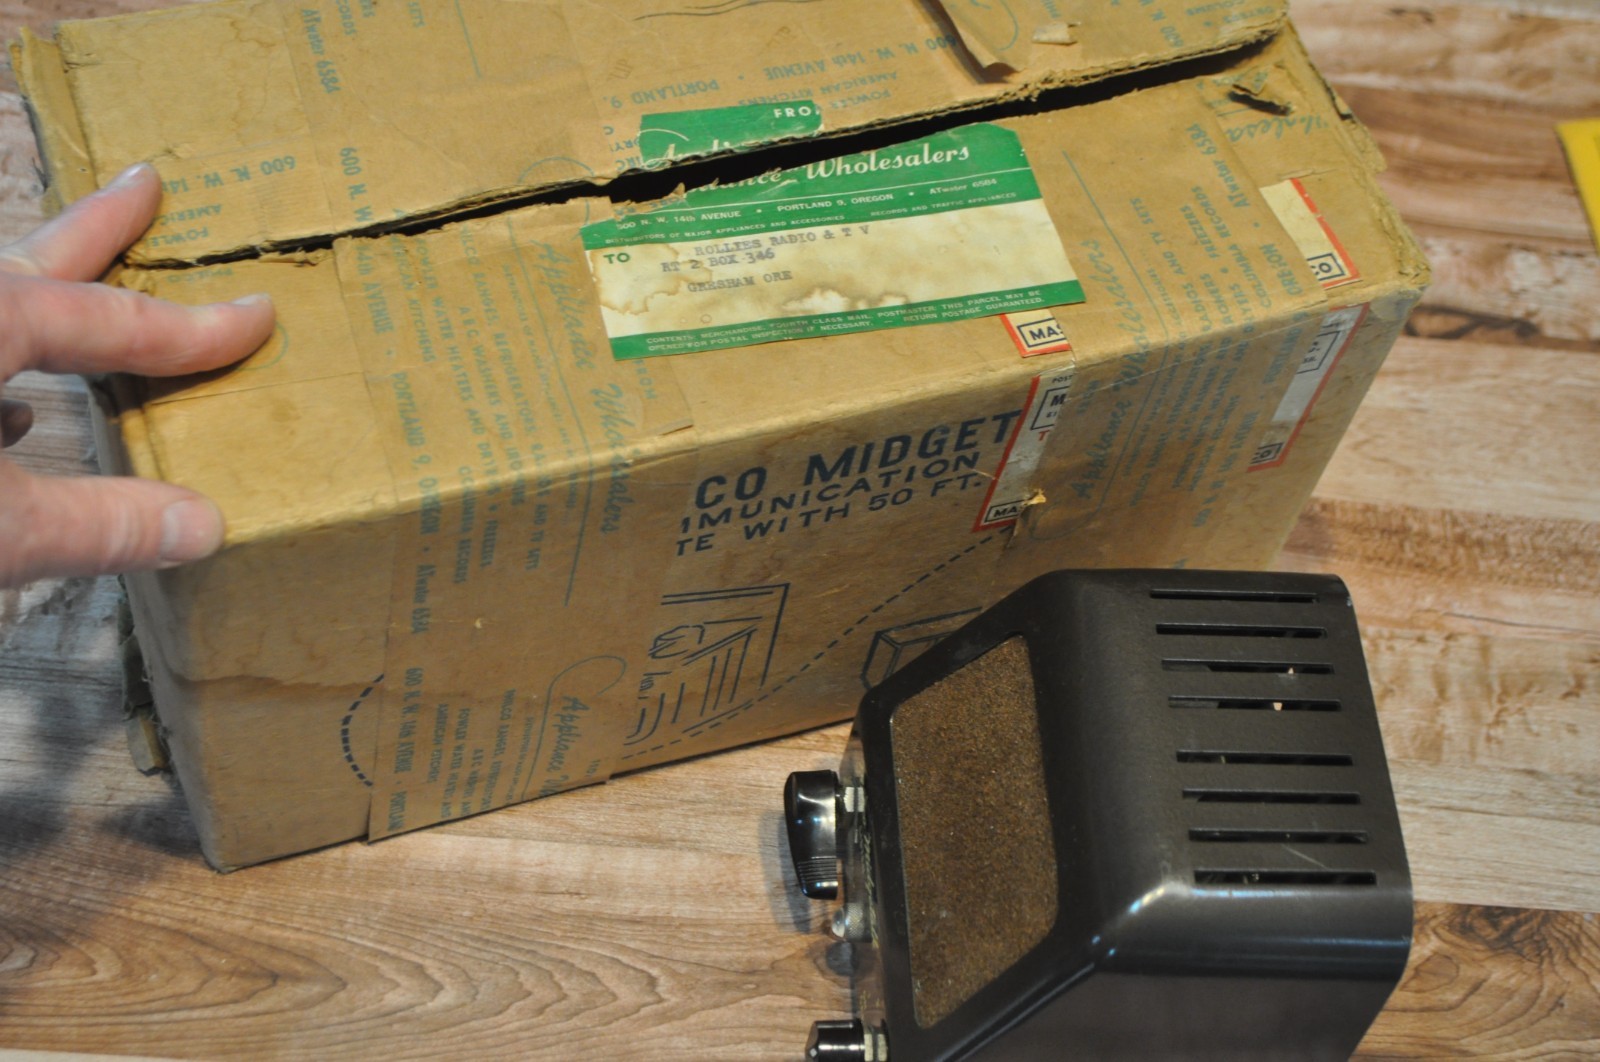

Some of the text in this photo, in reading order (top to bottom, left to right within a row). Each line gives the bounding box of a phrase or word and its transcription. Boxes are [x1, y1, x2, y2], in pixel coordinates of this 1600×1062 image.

[831, 51, 866, 67] 14th
[926, 34, 957, 50] 600
[763, 59, 826, 80] AVENUE
[820, 72, 897, 94] AMERICAN
[630, 79, 720, 104] PORTLAND
[831, 89, 892, 109] FOWLER
[1187, 123, 1217, 155] 6584
[259, 155, 296, 176] 600
[803, 143, 970, 180] Wholesalers
[1213, 159, 1250, 208] ATwater
[605, 233, 665, 244] DISTRIBUTORS
[716, 223, 766, 234] APPLIANCES
[790, 215, 845, 226] ACCESSORIES
[870, 207, 908, 217] RECORDS
[931, 200, 964, 209] TRAFFIC
[968, 192, 1016, 204] APPLIANCES
[673, 214, 695, 223] 14th
[700, 210, 742, 221] AVENUE
[777, 200, 832, 212] PORTLAND
[851, 193, 894, 204] OREGON
[929, 184, 967, 195] ATwater
[769, 232, 817, 247] RADIO
[822, 230, 836, 240] &
[841, 228, 853, 237] T
[859, 225, 870, 235] V
[1179, 205, 1221, 258] FREEZERS
[1191, 185, 1271, 308] COLUMBIA RECORDS
[603, 252, 631, 264] TO
[661, 261, 681, 273] RT
[690, 260, 701, 270] 2
[708, 254, 738, 268] BOX
[1130, 198, 1213, 332] RADIOS AND TV SETS
[339, 146, 362, 176] 600
[362, 282, 395, 335] AVENUE
[392, 371, 426, 447] PORTLAND
[687, 271, 793, 293] GRESHAM ORE
[530, 239, 597, 370] Appliance
[812, 316, 843, 325] CLASS
[941, 302, 963, 310] THIS
[967, 296, 1001, 306] PARCEL
[1005, 292, 1025, 300] MAY
[1028, 289, 1041, 297] BE
[407, 298, 437, 363] KITCHENS
[415, 237, 439, 289] FOWLER
[431, 296, 455, 340] WATER
[448, 345, 474, 402] HEATERS
[466, 408, 487, 435] AND
[648, 342, 687, 351] OPENED
[689, 339, 708, 348] FOR
[710, 335, 749, 346] POSTAL
[752, 327, 804, 340] INSPECTION
[903, 313, 938, 322] RETURN
[942, 306, 982, 318] POSTAGE
[1070, 239, 1151, 499] Appliance Wholesalers
[472, 344, 501, 406] WASHERS
[494, 413, 513, 440] AND
[696, 409, 1024, 510] CO MIDGET
[533, 503, 548, 525] AND
[676, 472, 982, 556] TE WITH 50 FT.
[525, 548, 541, 571] SETS
[404, 667, 424, 687] 600
[546, 695, 590, 773] Appliance
[394, 742, 415, 774] AVENUE
